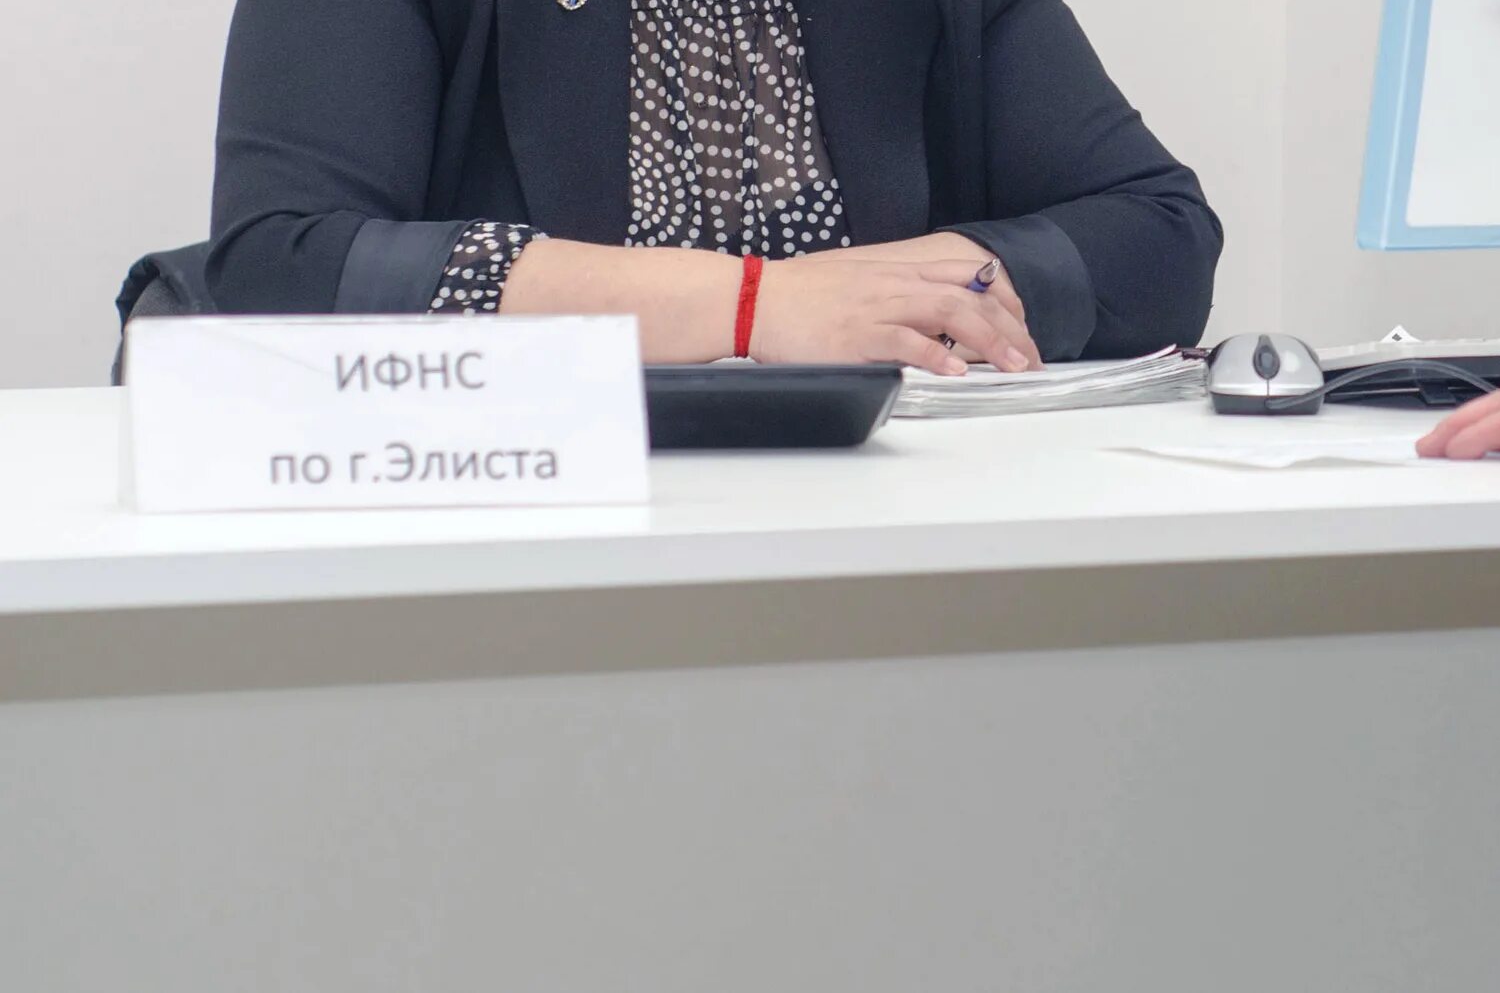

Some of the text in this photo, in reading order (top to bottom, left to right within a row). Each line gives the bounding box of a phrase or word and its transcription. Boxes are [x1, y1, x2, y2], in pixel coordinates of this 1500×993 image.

[336, 352, 487, 391] ИФНС
[270, 441, 559, 484] по г.Элиста
